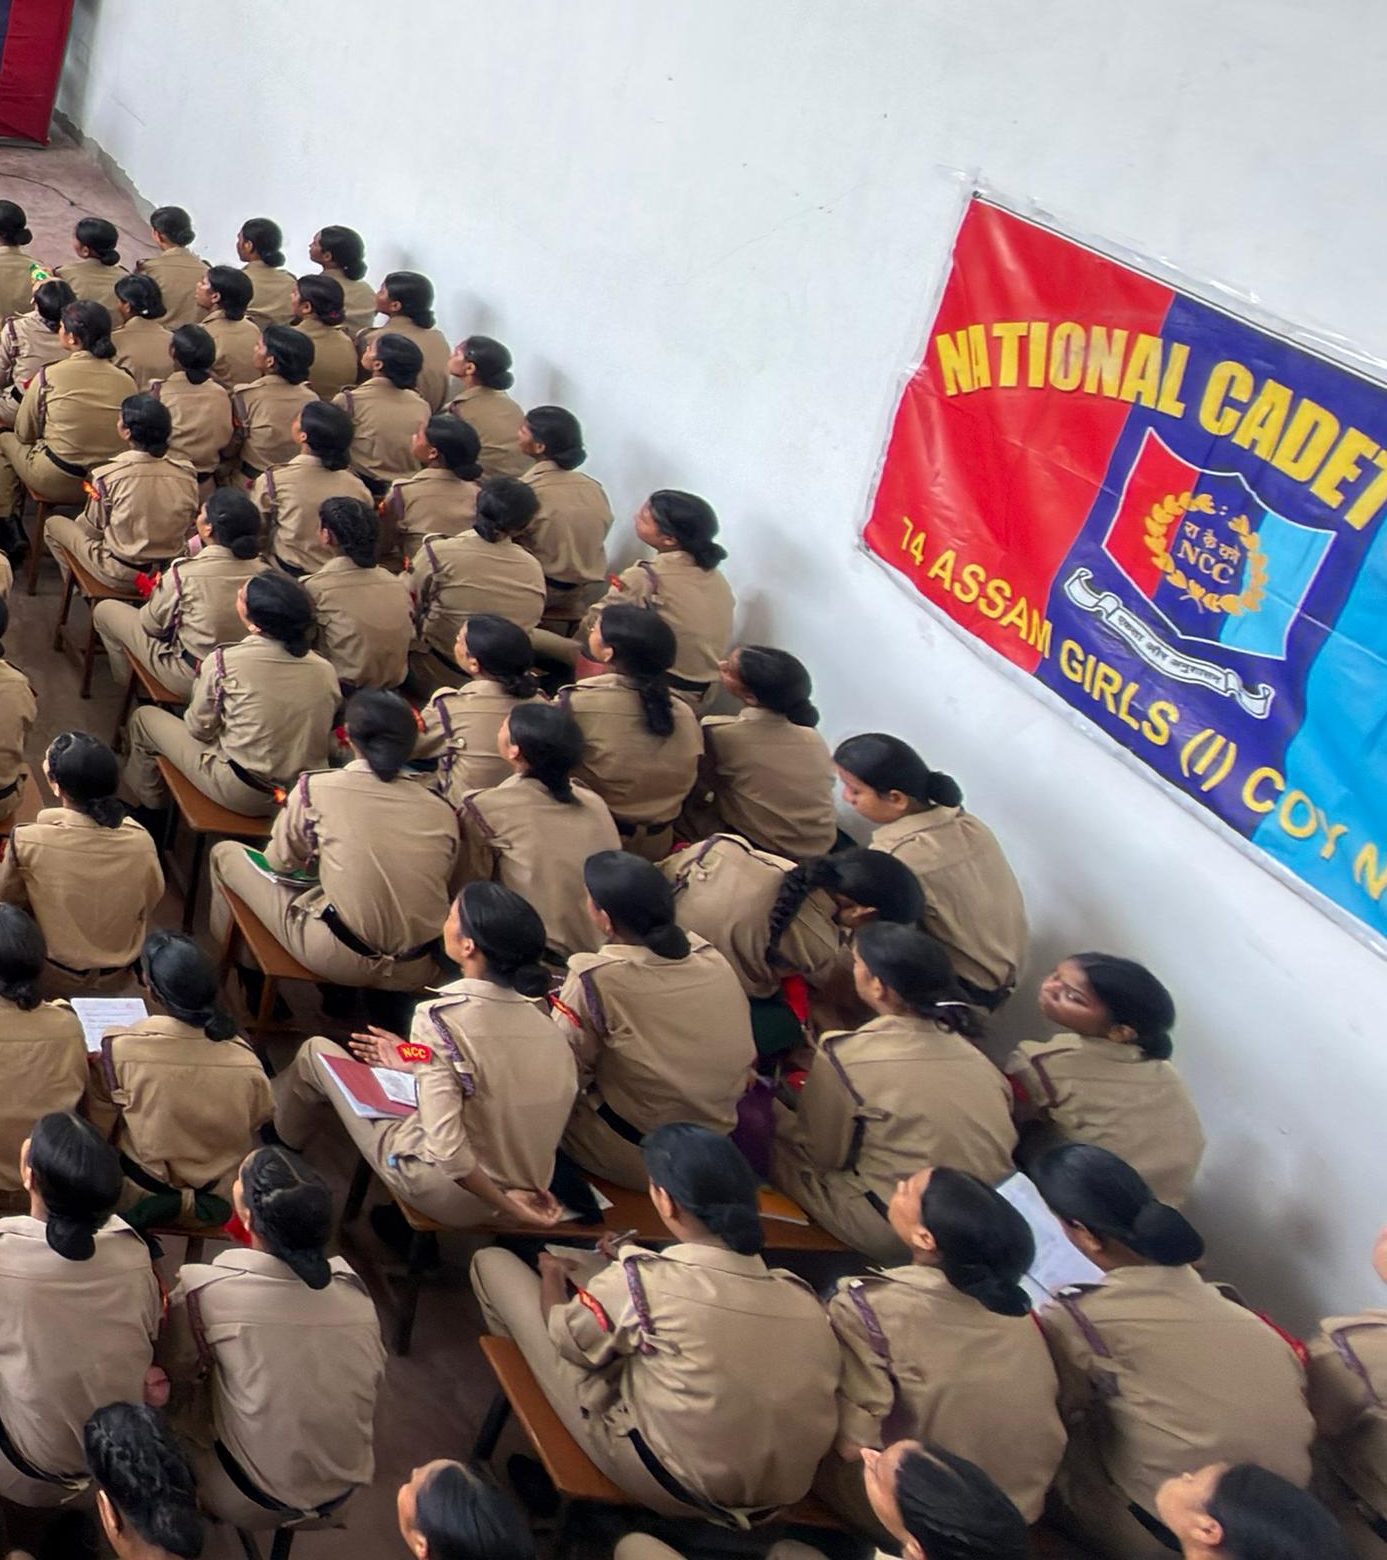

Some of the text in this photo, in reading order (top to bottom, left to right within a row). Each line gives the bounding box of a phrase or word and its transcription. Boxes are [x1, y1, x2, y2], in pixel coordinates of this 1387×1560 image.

[935, 321, 1191, 419] NATIONAL
[1176, 539, 1235, 584] NCC
[901, 516, 926, 567] 74
[927, 547, 1053, 660] ASSAM
[1060, 638, 1180, 747] GIRLS
[1179, 727, 1237, 795] (I)
[1242, 766, 1347, 856] COY
[402, 1046, 428, 1060] NCC
